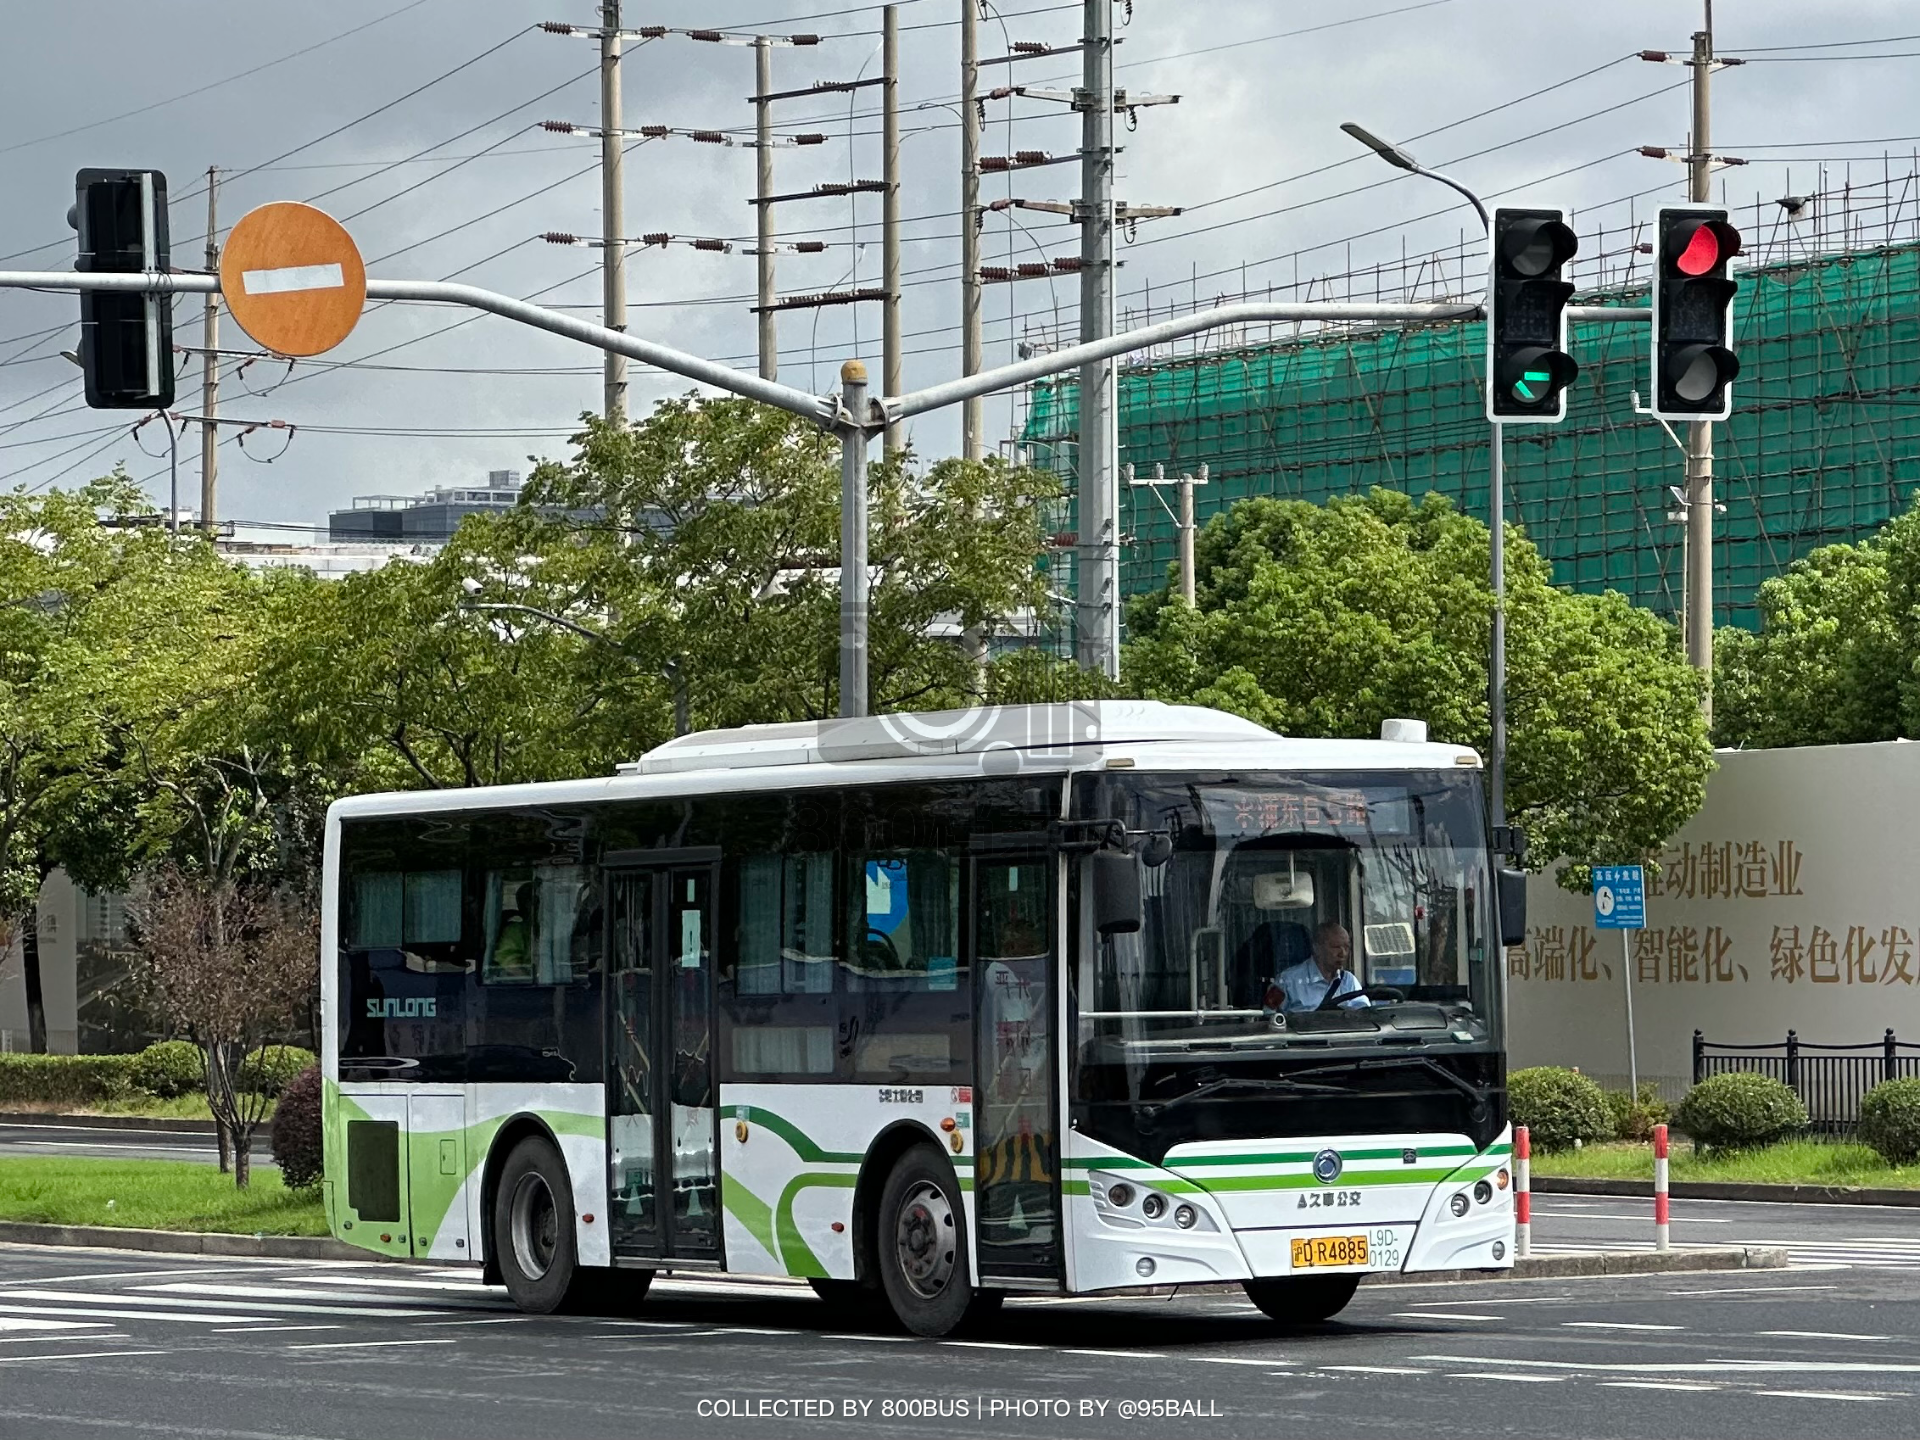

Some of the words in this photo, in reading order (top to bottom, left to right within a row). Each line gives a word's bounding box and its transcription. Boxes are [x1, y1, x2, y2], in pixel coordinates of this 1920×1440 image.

[1507, 925, 1920, 986] 高端化、智能化、绿色化发
[366, 996, 437, 1018] SUNLONG
[1369, 1229, 1398, 1247] L9D-
[1369, 1249, 1400, 1267] 0129
